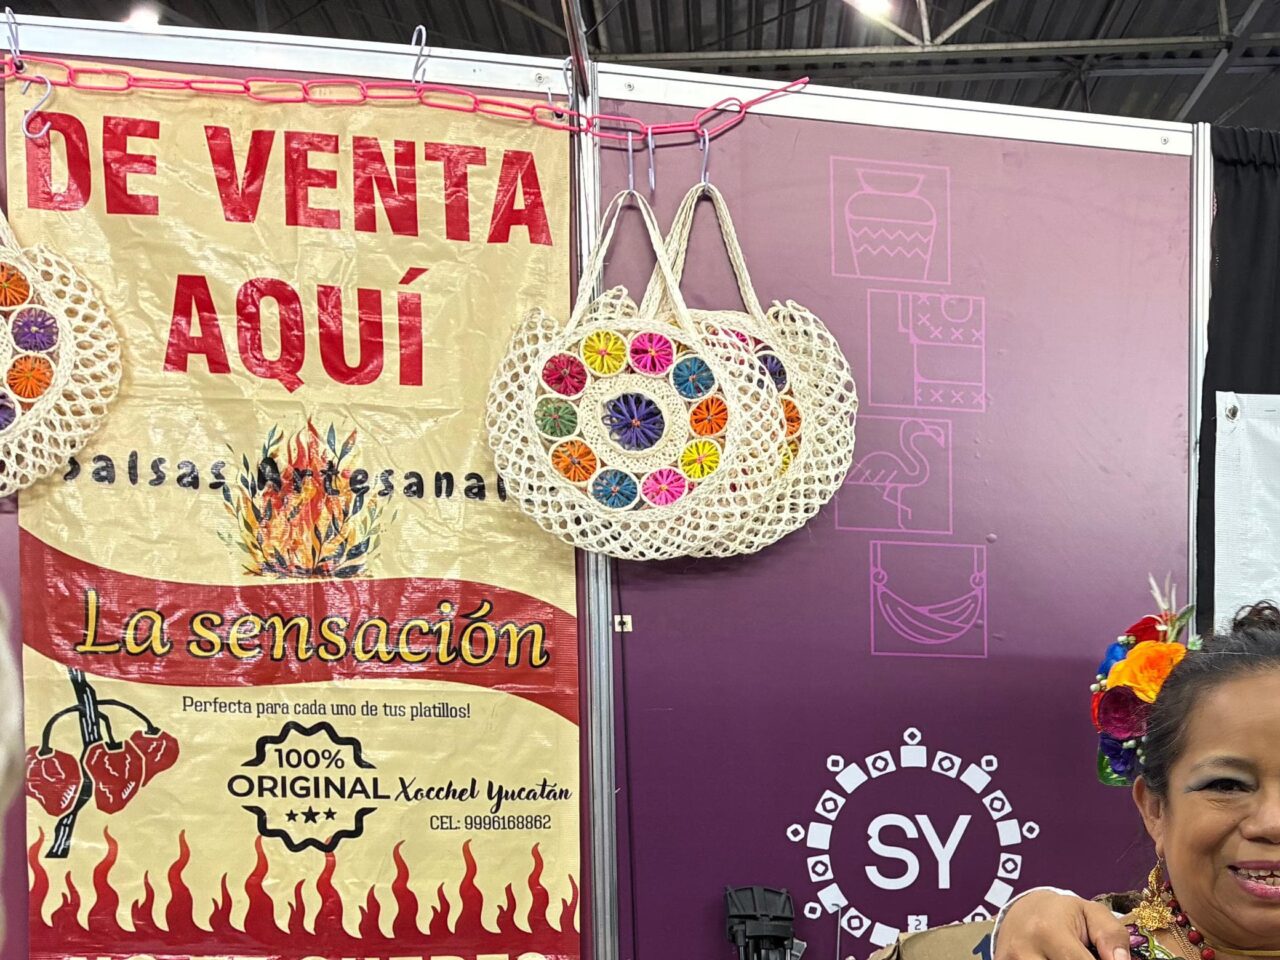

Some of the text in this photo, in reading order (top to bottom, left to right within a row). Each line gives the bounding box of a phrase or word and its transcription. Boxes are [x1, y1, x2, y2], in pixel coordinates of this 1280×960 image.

[24, 110, 552, 246] DE VENTA
[163, 267, 430, 393] AQUÍ
[75, 588, 550, 669] La sensación
[182, 696, 471, 721] Perfecta para cada uno de tus platillos!
[274, 748, 345, 769] 100%
[227, 774, 391, 800] ORIGINAL
[394, 776, 573, 814] Xocchel Yucatán
[430, 814, 552, 830] CEL: 9996168862
[865, 813, 972, 890] SY
